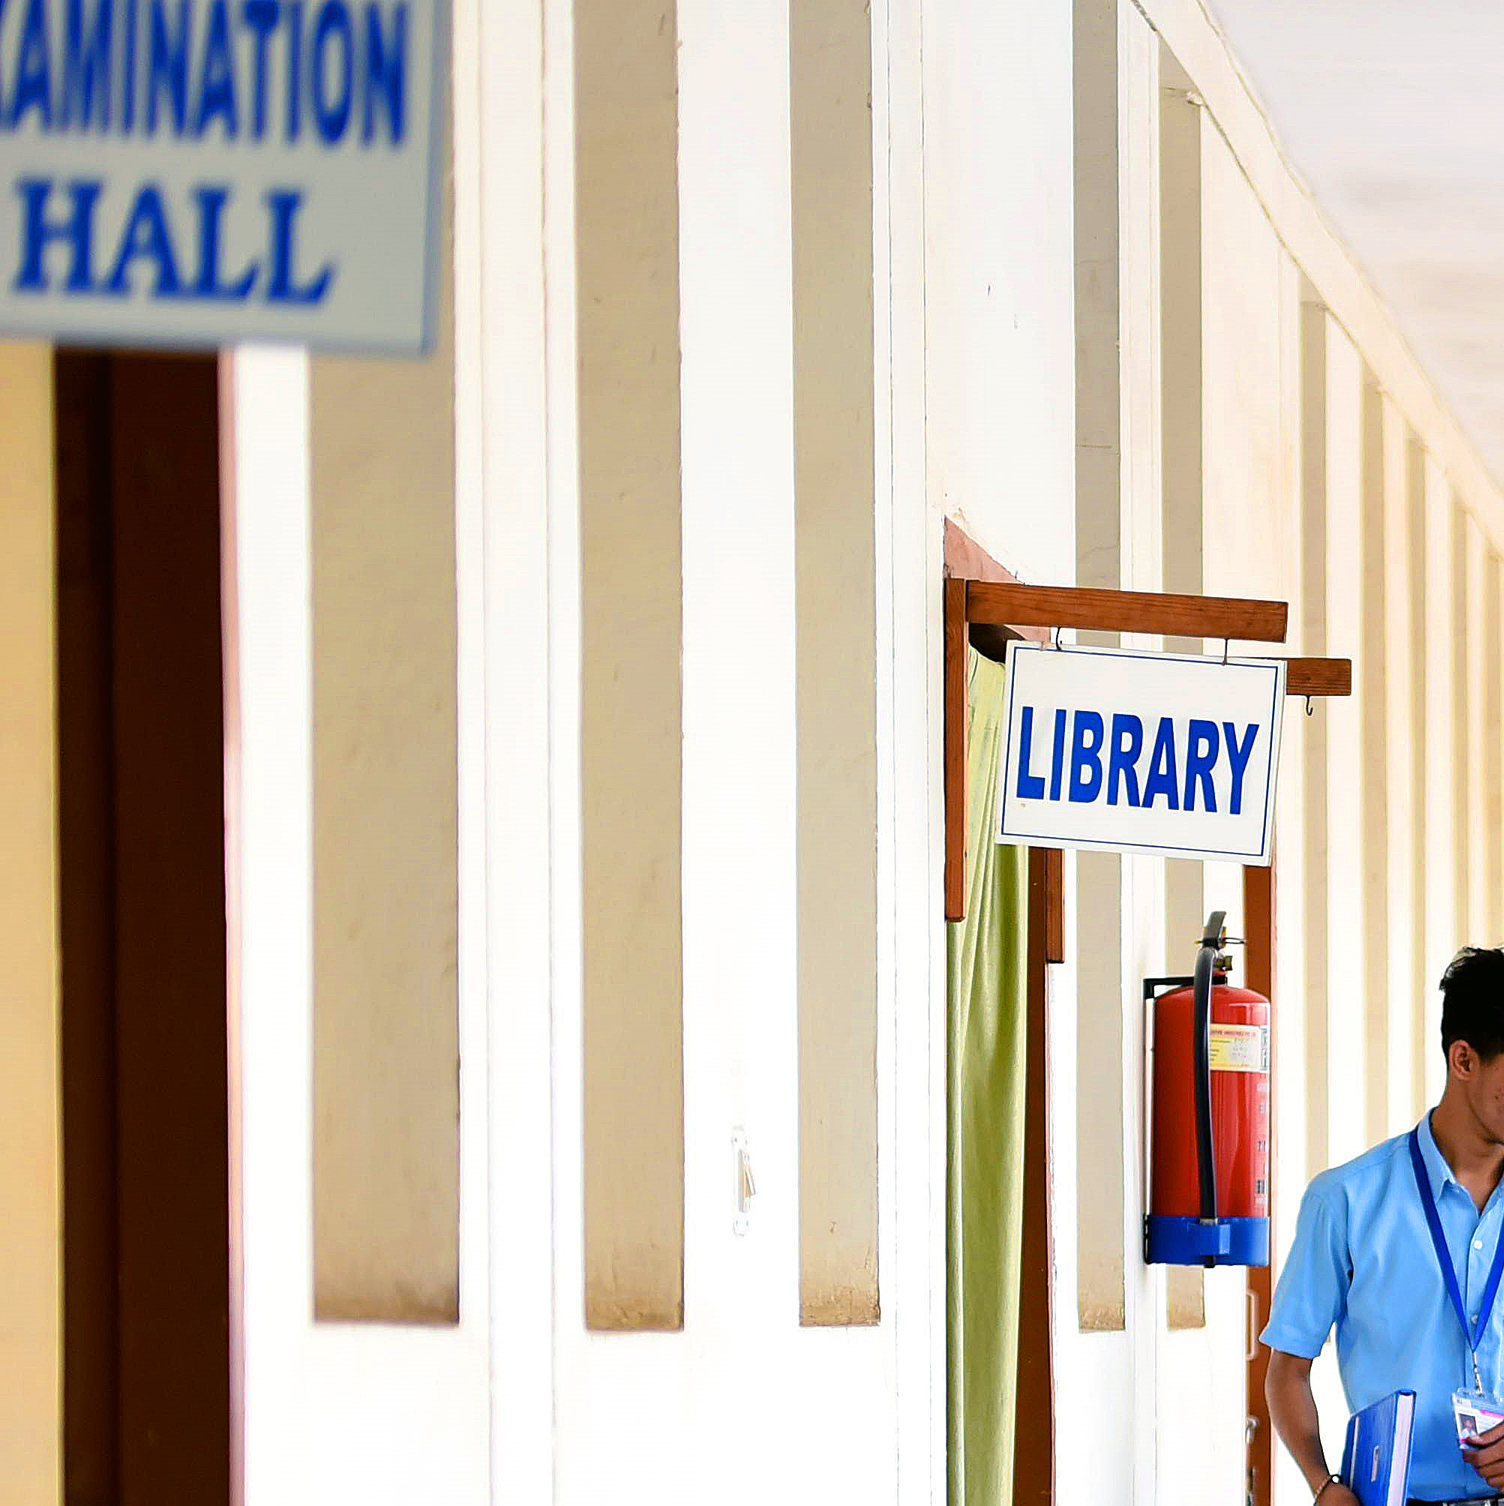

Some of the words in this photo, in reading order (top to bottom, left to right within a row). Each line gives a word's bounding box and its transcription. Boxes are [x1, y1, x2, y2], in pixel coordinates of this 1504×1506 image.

[0, 0, 408, 148] AMINATION
[13, 175, 336, 310] HALL
[1016, 706, 1260, 815] LIBRARY
